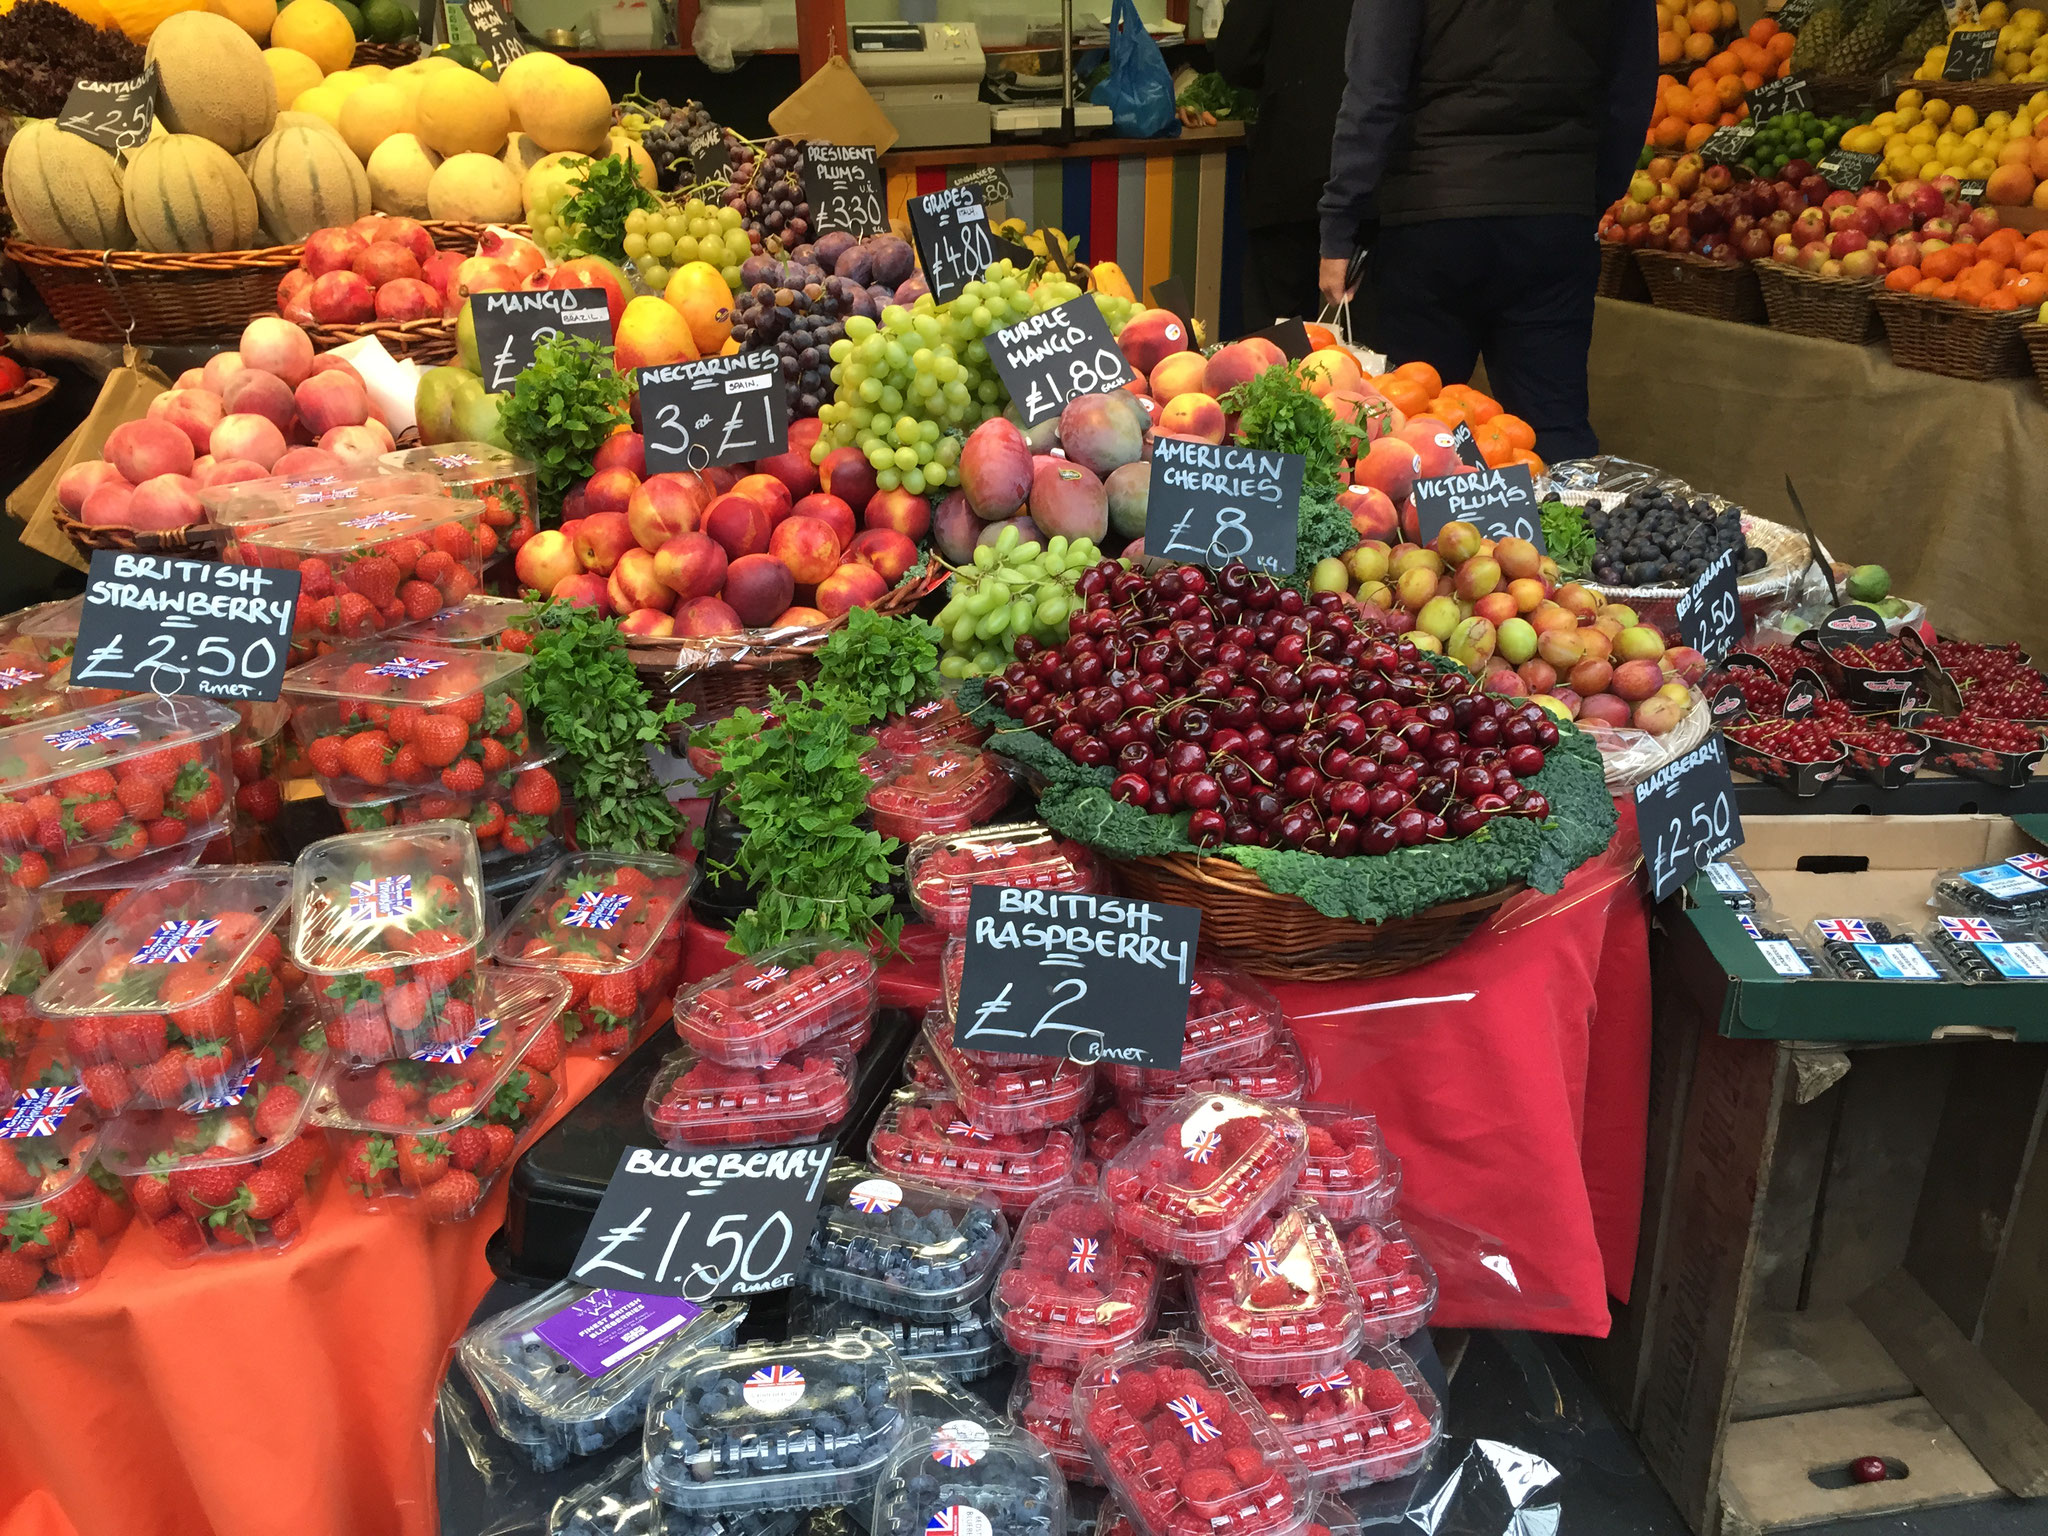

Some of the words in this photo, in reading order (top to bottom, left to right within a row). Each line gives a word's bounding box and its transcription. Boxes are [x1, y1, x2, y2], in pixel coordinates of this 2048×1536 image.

[1944, 49, 1963, 75] 2
[59, 95, 154, 136] £2.50
[1753, 104, 1769, 131] 2
[807, 146, 876, 164] PRESIDENT
[954, 167, 995, 186] UNWAXED
[816, 194, 881, 232] £3.30
[922, 186, 974, 216] GRAPES
[932, 223, 993, 298] £4.80
[487, 289, 578, 315] MANGO
[997, 306, 1071, 348] PURPLE
[1006, 327, 1093, 369] MANGO.
[1025, 348, 1122, 423] £1.80
[650, 404, 690, 455] 3
[717, 395, 775, 459] £1
[1155, 438, 1284, 481] AMERICAN
[1417, 469, 1507, 500] VICTORIA
[1163, 507, 1254, 559] £8
[113, 554, 273, 596] BRITISH
[1676, 593, 1691, 622] RED
[1692, 548, 1733, 600] CURRANT
[86, 580, 292, 636] STRAWBERRY
[76, 633, 277, 681] £2.50
[1654, 791, 1730, 897] £2.50
[999, 888, 1164, 936] BRITISH
[975, 916, 1188, 985] RASPBERRY
[964, 978, 1105, 1040] £2
[625, 1147, 832, 1203] BLUEBERRY
[574, 1207, 794, 1286] £1.50
[578, 1318, 608, 1338] FINEST
[609, 1297, 642, 1318] BRITISH
[589, 1304, 645, 1339] BLUEBERRIES
